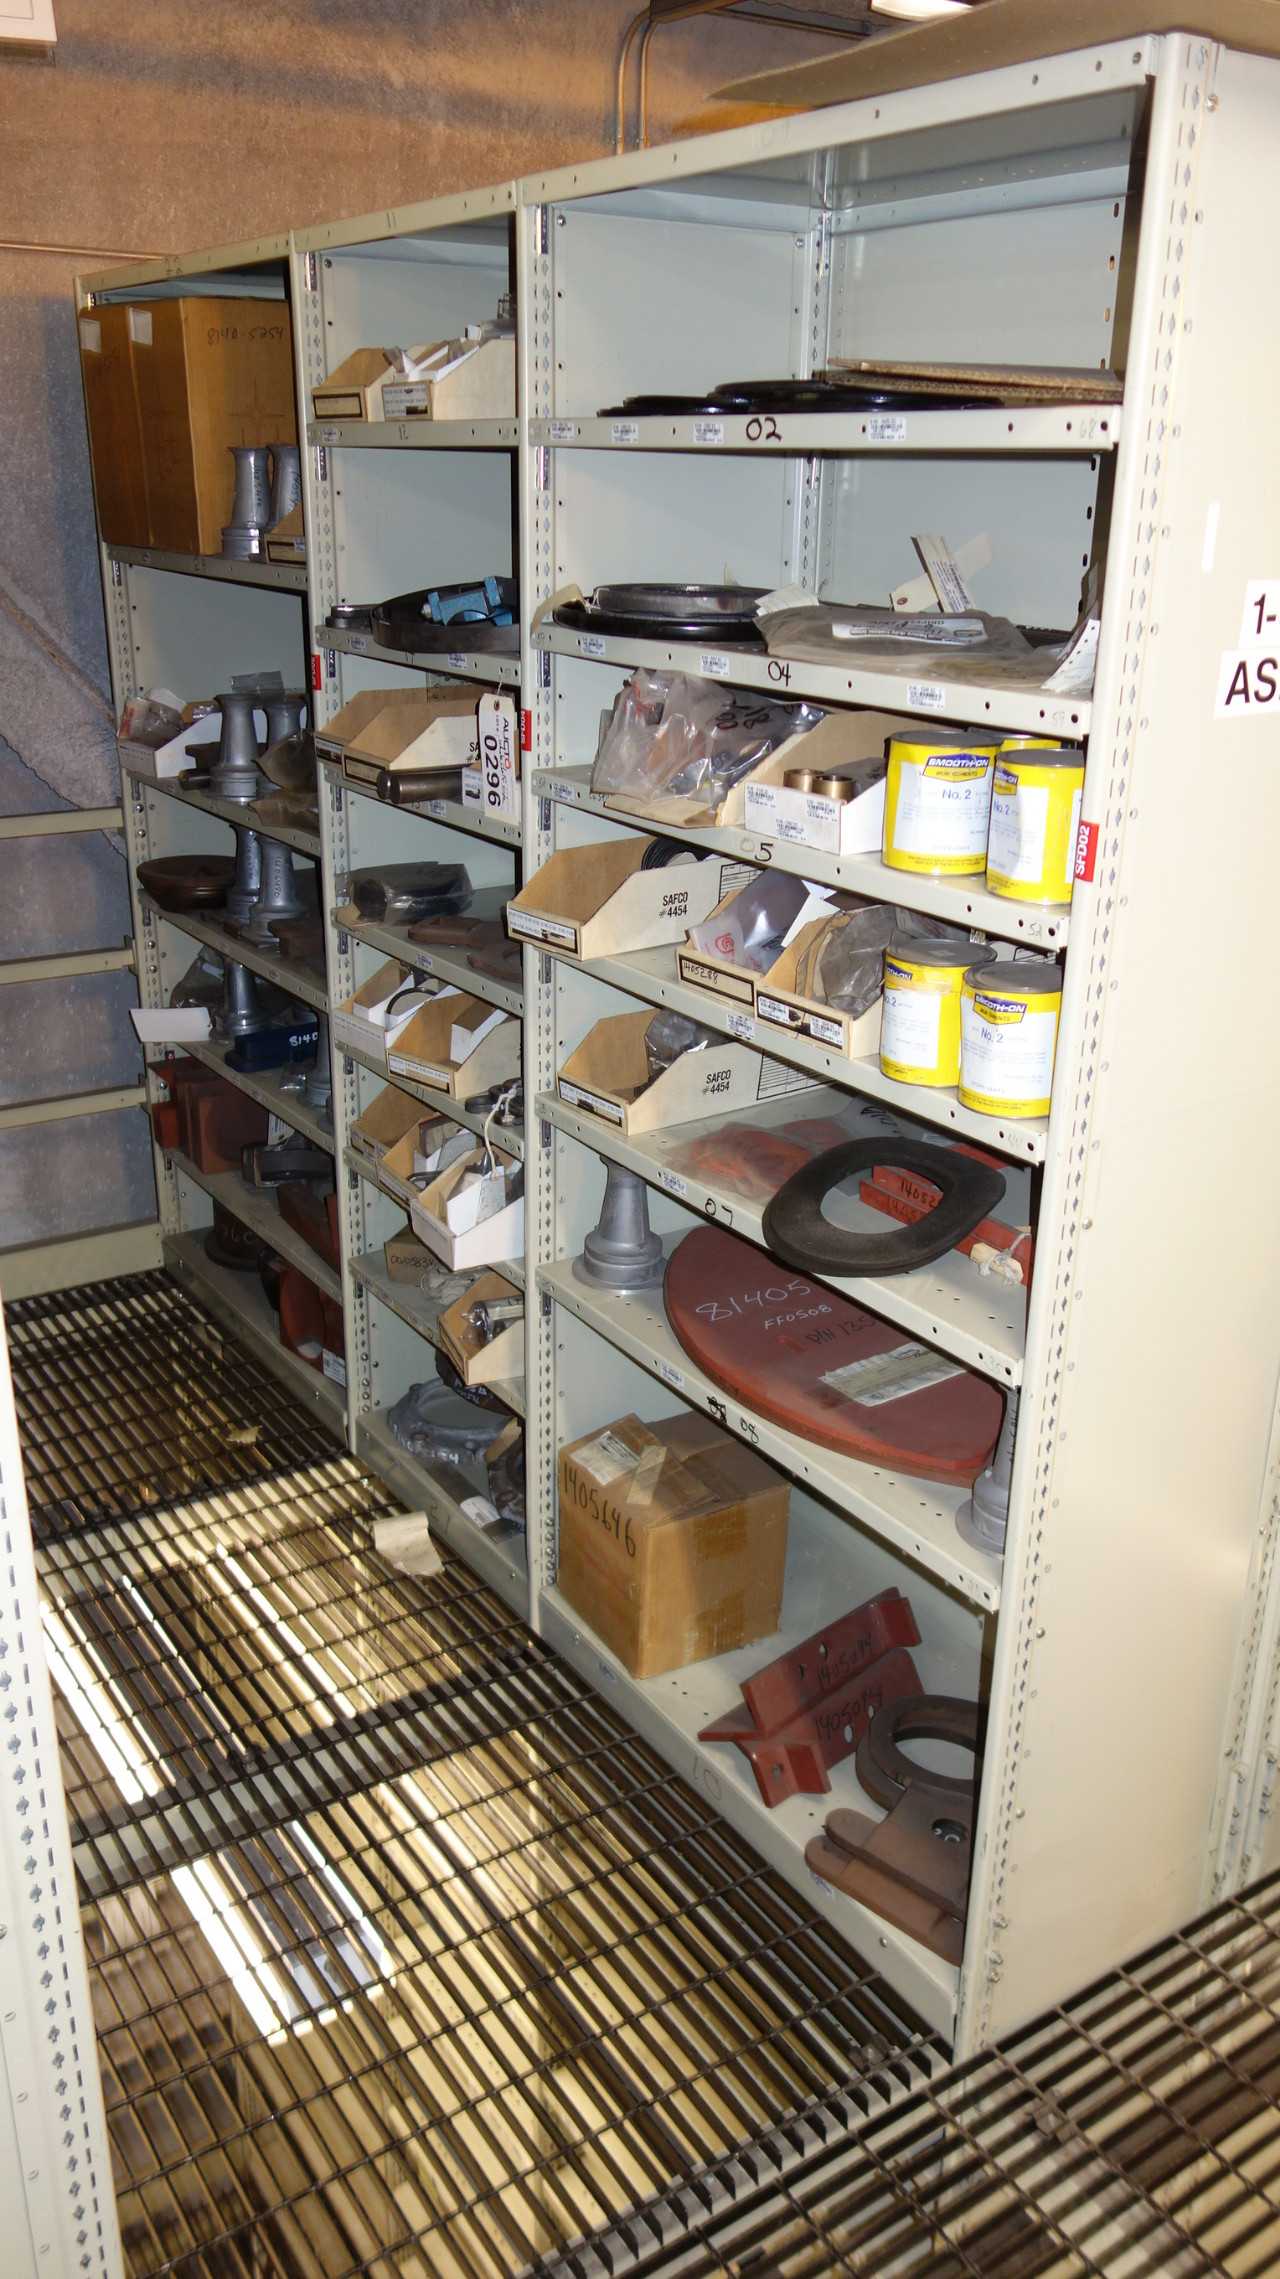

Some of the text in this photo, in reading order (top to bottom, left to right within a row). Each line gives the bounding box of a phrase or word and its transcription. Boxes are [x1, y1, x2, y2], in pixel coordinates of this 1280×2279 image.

[746, 416, 783, 442] 02
[1254, 593, 1280, 635] 1-
[767, 660, 792, 687] 04
[1224, 657, 1280, 706] AS
[483, 734, 502, 808] 0296
[928, 756, 989, 769] SMOOTH-ON
[941, 788, 973, 801] No. 2
[1074, 824, 1091, 876] SFD02
[662, 891, 689, 907] SAFCO
[995, 1033, 1005, 1044] 2
[705, 1069, 731, 1085] SAFCO
[704, 1197, 734, 1226] 07
[695, 1279, 811, 1322] 81405
[740, 1416, 760, 1444] 08
[563, 1460, 637, 1558] 1405646
